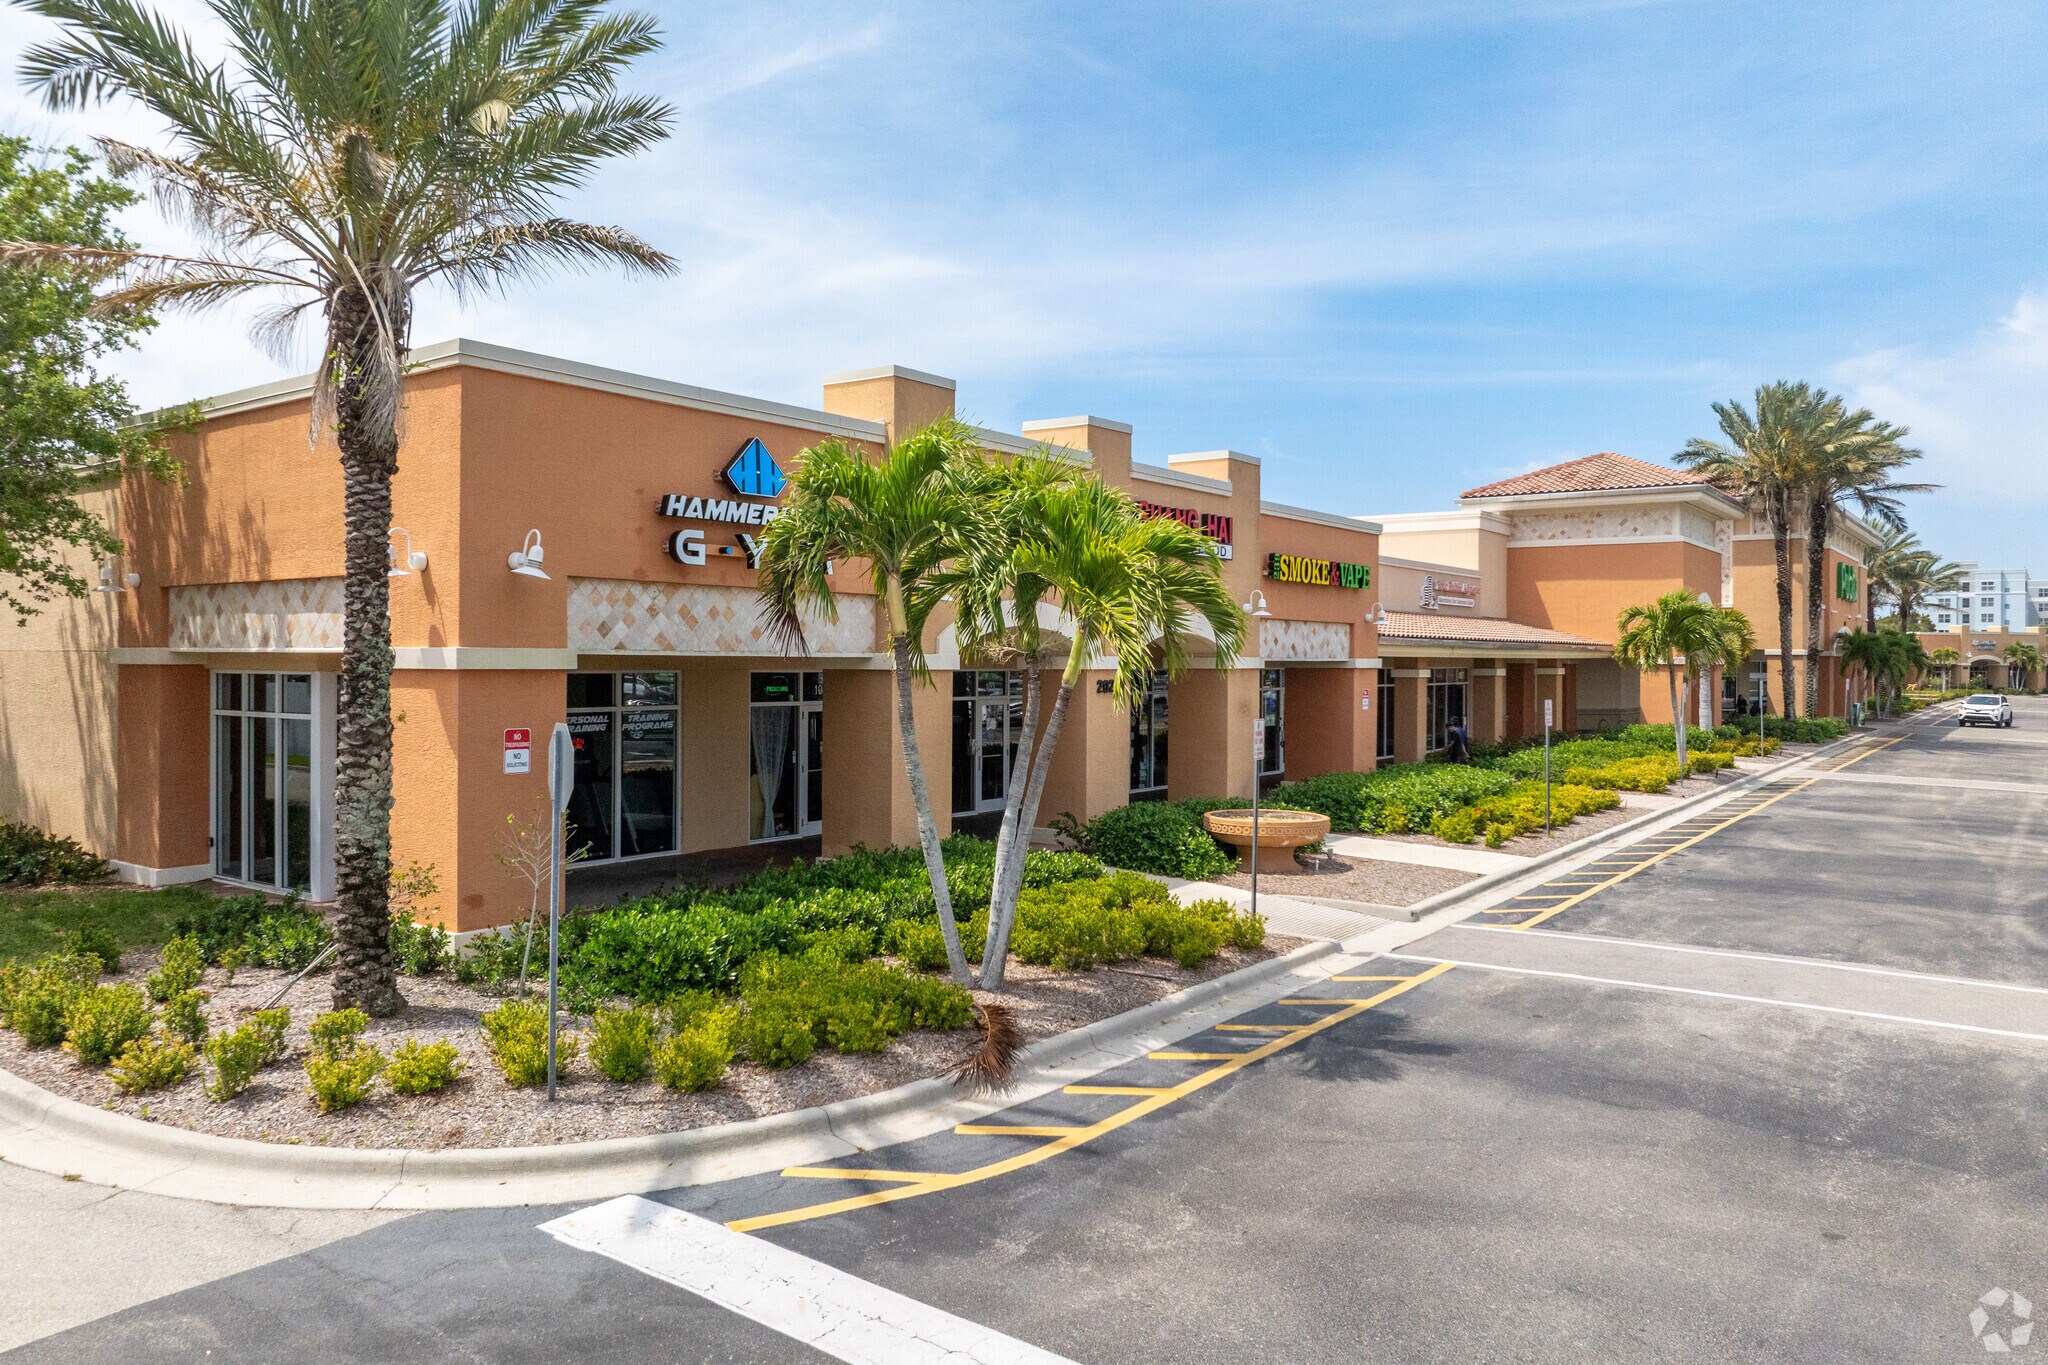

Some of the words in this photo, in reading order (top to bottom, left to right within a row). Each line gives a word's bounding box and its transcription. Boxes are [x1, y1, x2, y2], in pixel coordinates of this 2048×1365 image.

[1207, 513, 1234, 544] HAI
[1280, 554, 1331, 586] SMOKE
[1330, 562, 1340, 587] &
[1339, 562, 1371, 589] VAPE
[567, 714, 610, 725] ERSONAL
[628, 713, 670, 722] TRAINING
[569, 723, 607, 733] RAINING
[622, 721, 674, 731] PROGRAMS
[513, 752, 522, 760] NO
